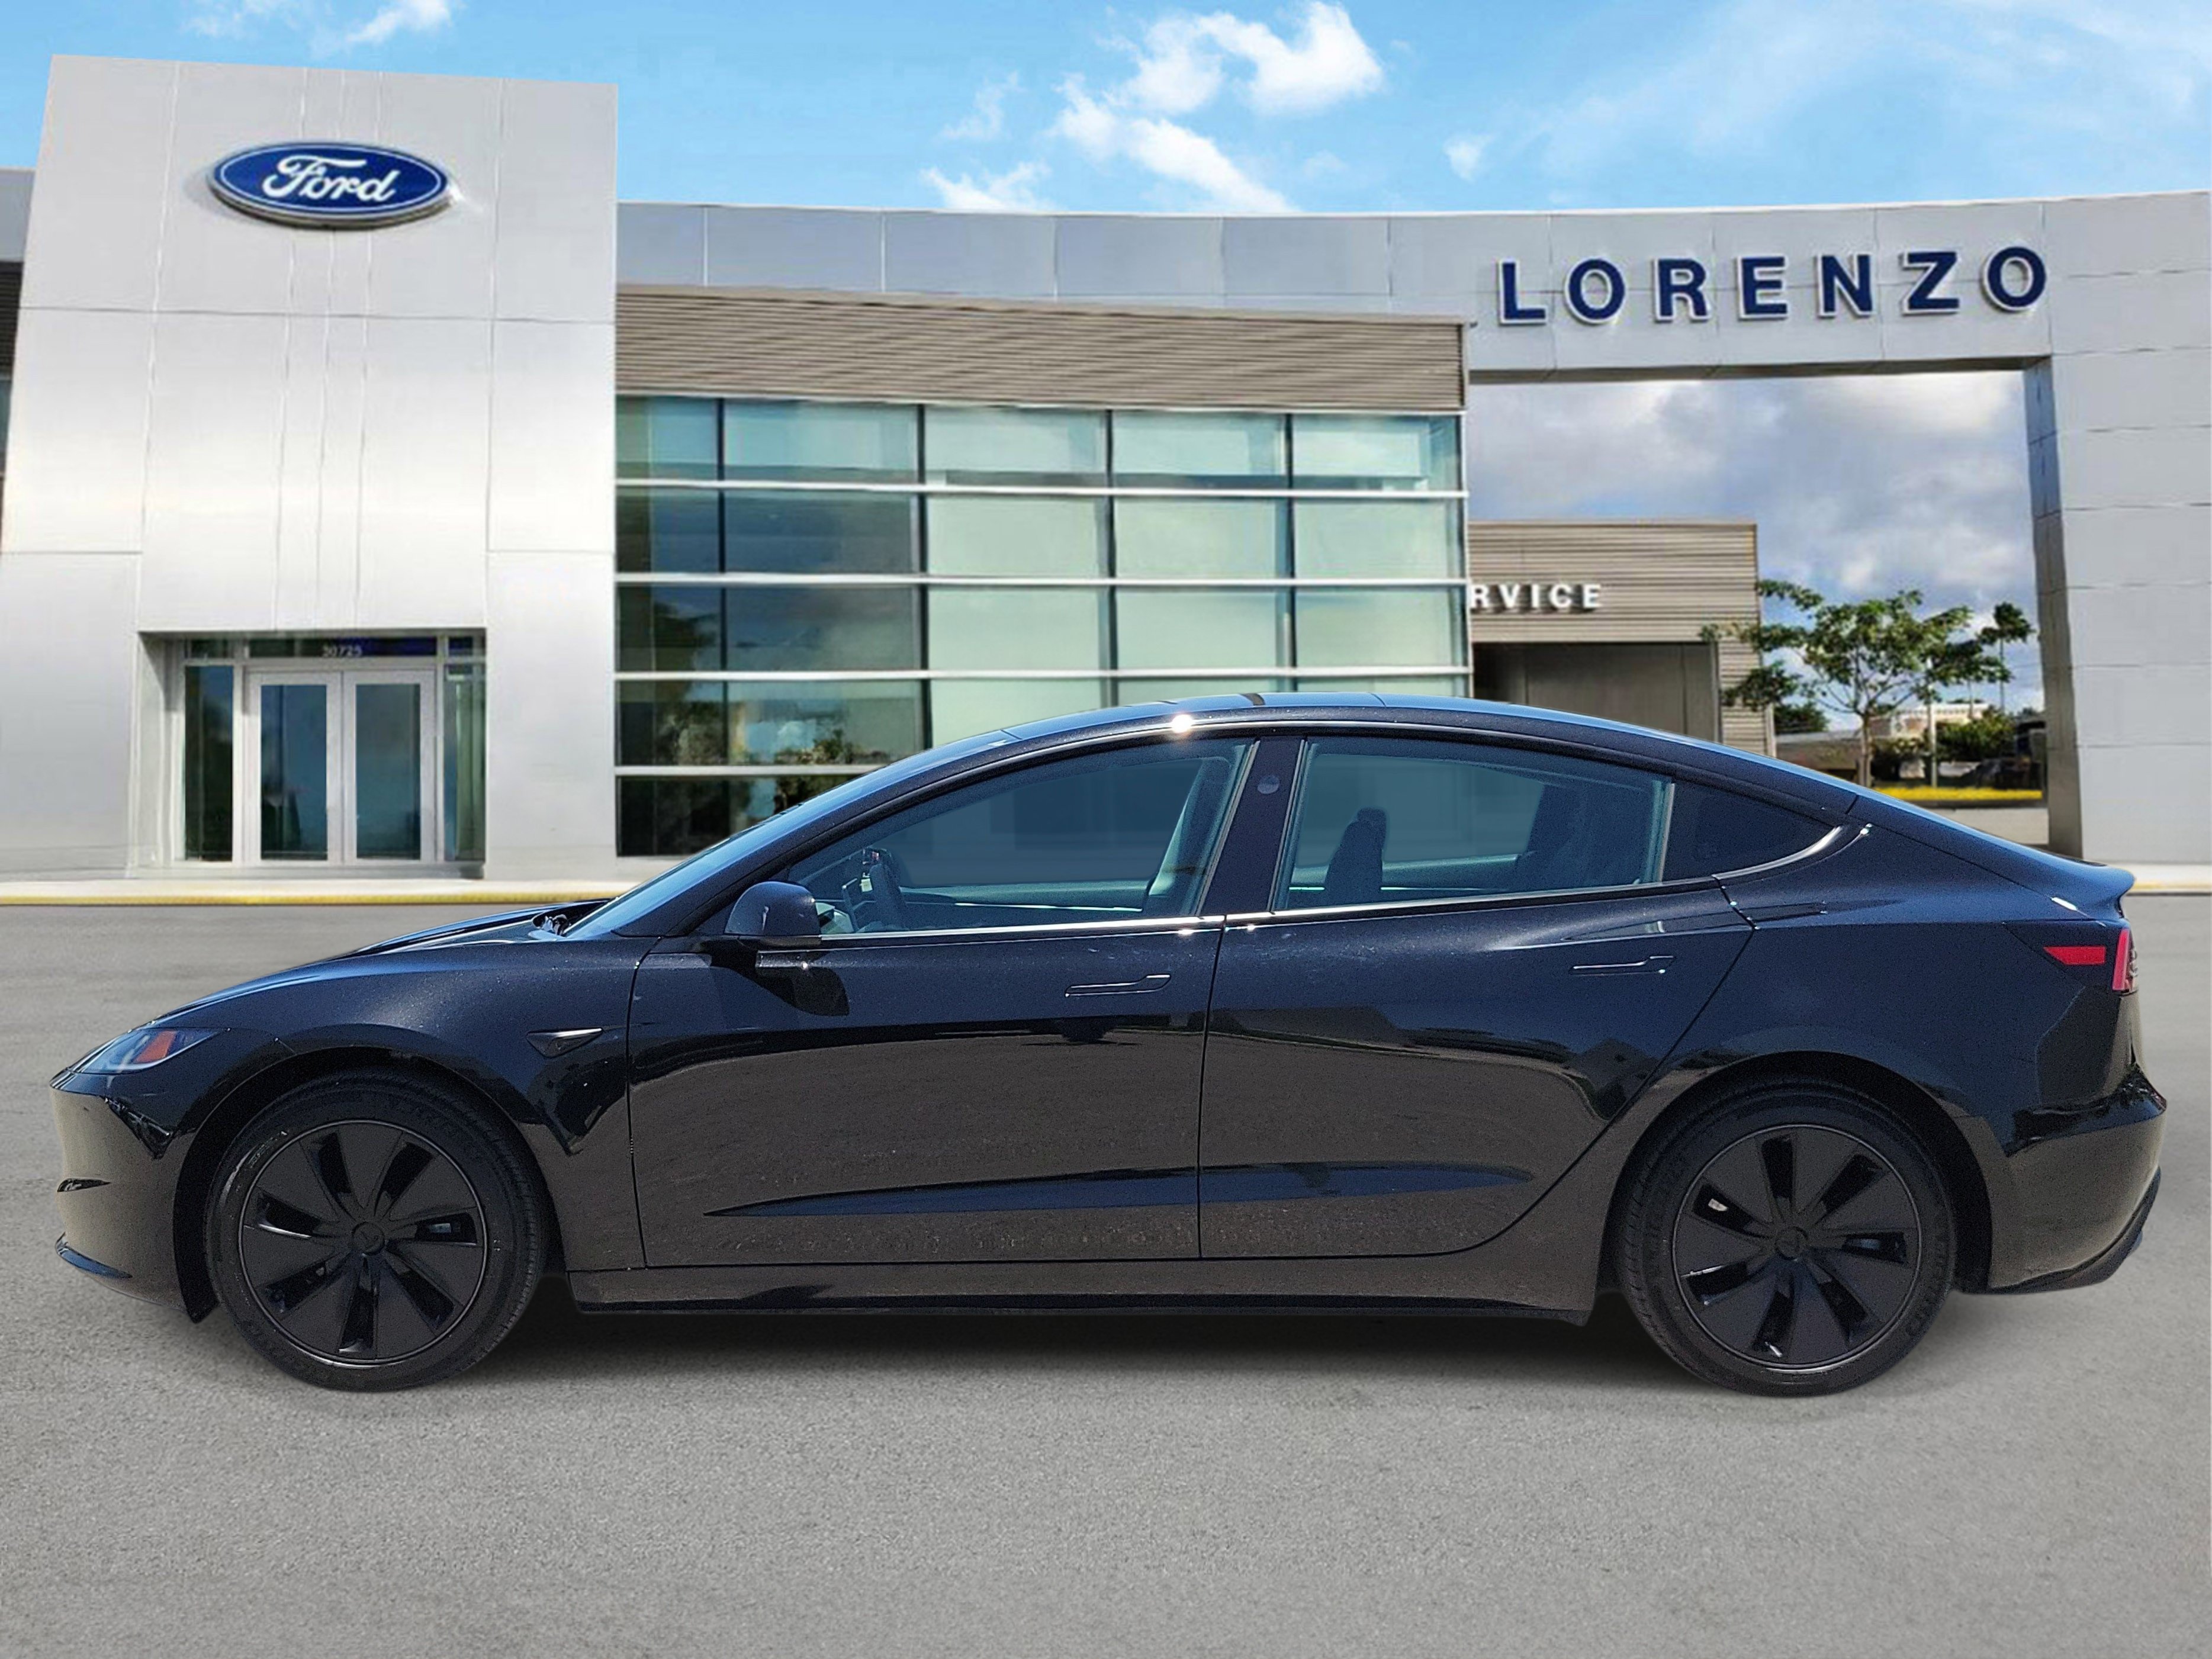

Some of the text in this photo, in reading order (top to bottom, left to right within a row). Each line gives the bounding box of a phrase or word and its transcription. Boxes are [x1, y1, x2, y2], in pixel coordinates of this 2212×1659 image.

[262, 155, 400, 202] Ford
[1498, 245, 2047, 326] LORENZO
[1470, 583, 1603, 609] RVICE
